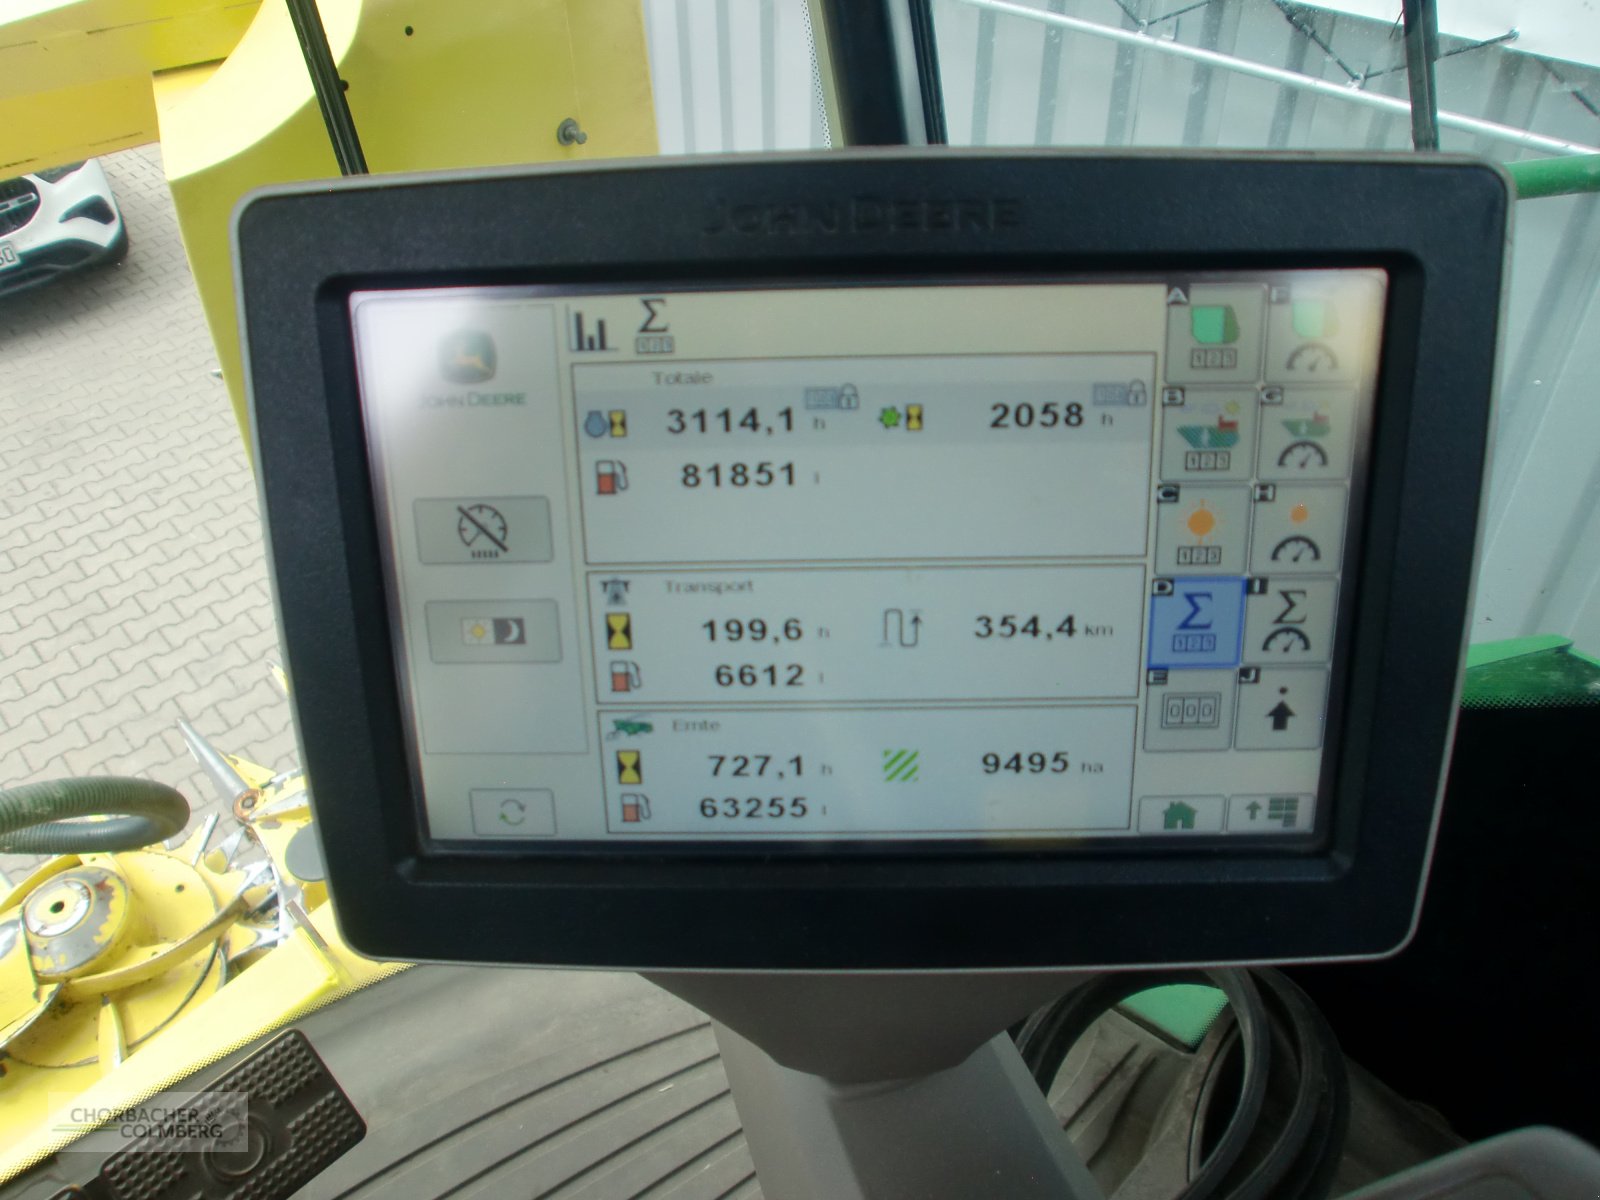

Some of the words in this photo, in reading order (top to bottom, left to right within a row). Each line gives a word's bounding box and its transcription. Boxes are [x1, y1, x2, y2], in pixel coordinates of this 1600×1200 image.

[1168, 287, 1188, 304] A
[652, 371, 713, 386] Totale
[1165, 389, 1183, 405] B
[667, 406, 795, 436] 3114,1
[812, 415, 826, 431] h
[990, 402, 1084, 428] 2058
[682, 461, 795, 488] 81851
[1256, 486, 1273, 500] H
[665, 580, 754, 596] Transport
[1154, 580, 1173, 595] D
[703, 617, 803, 644] 199,6
[975, 614, 1077, 641] 354,4
[1084, 624, 1114, 637] km
[715, 664, 805, 688] 6612
[708, 754, 804, 780] 727,1
[982, 751, 1069, 774] 9495
[1081, 761, 1103, 774] ha
[700, 796, 808, 819] 63255
